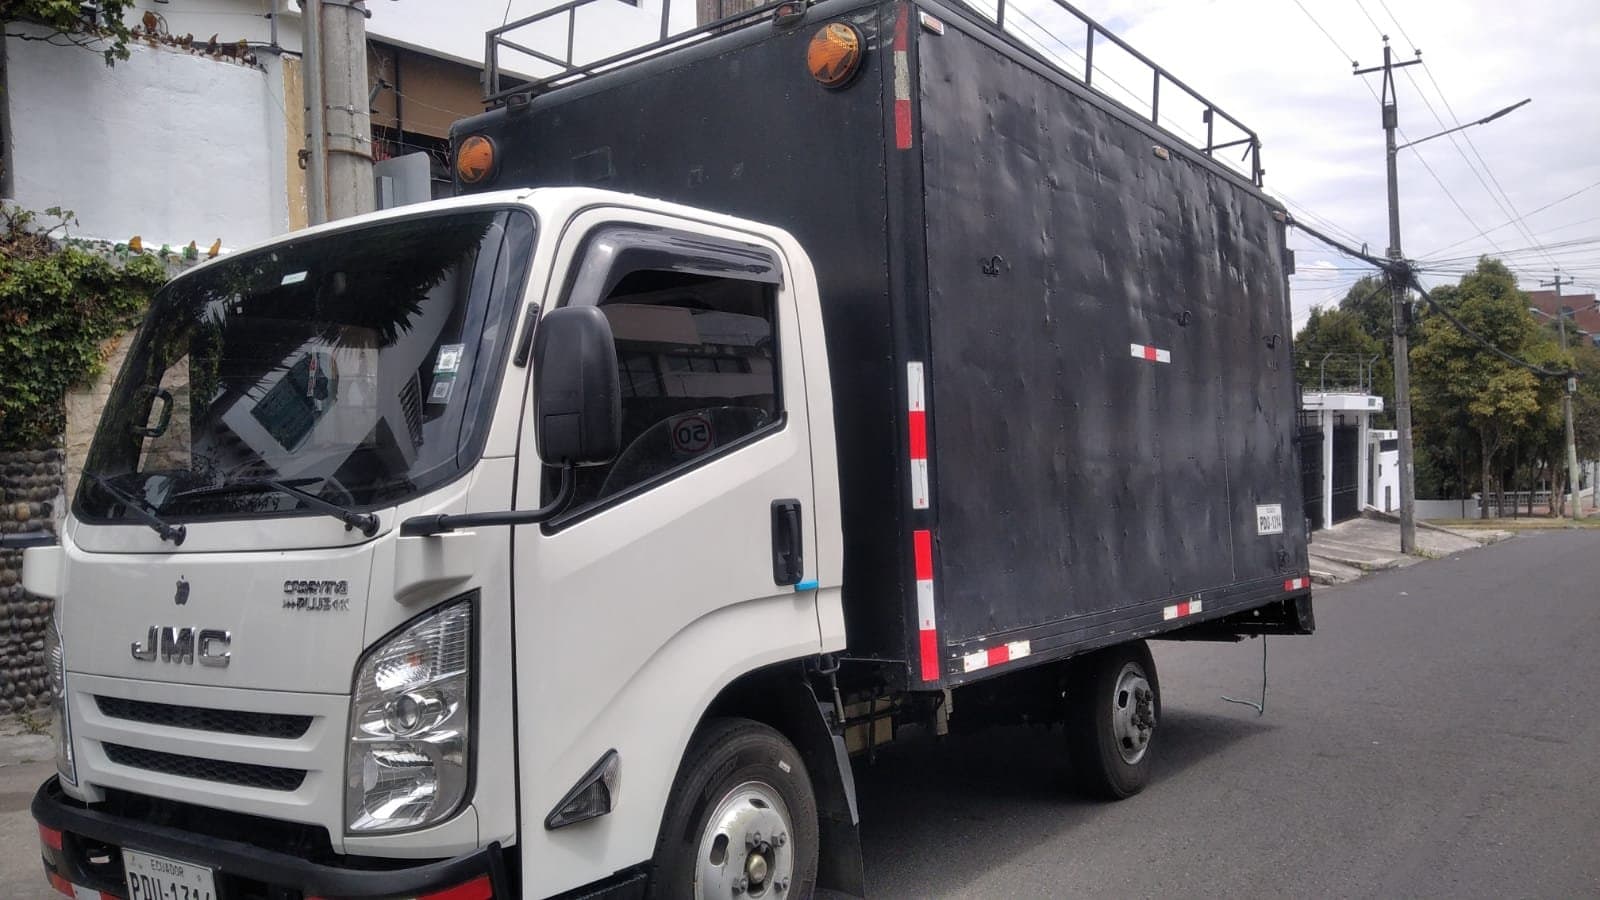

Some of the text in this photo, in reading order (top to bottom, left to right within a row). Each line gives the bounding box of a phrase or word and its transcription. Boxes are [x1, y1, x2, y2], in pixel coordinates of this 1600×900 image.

[297, 597, 332, 611] PLUS
[131, 624, 231, 668] JMC
[150, 859, 184, 877] ECUADOR
